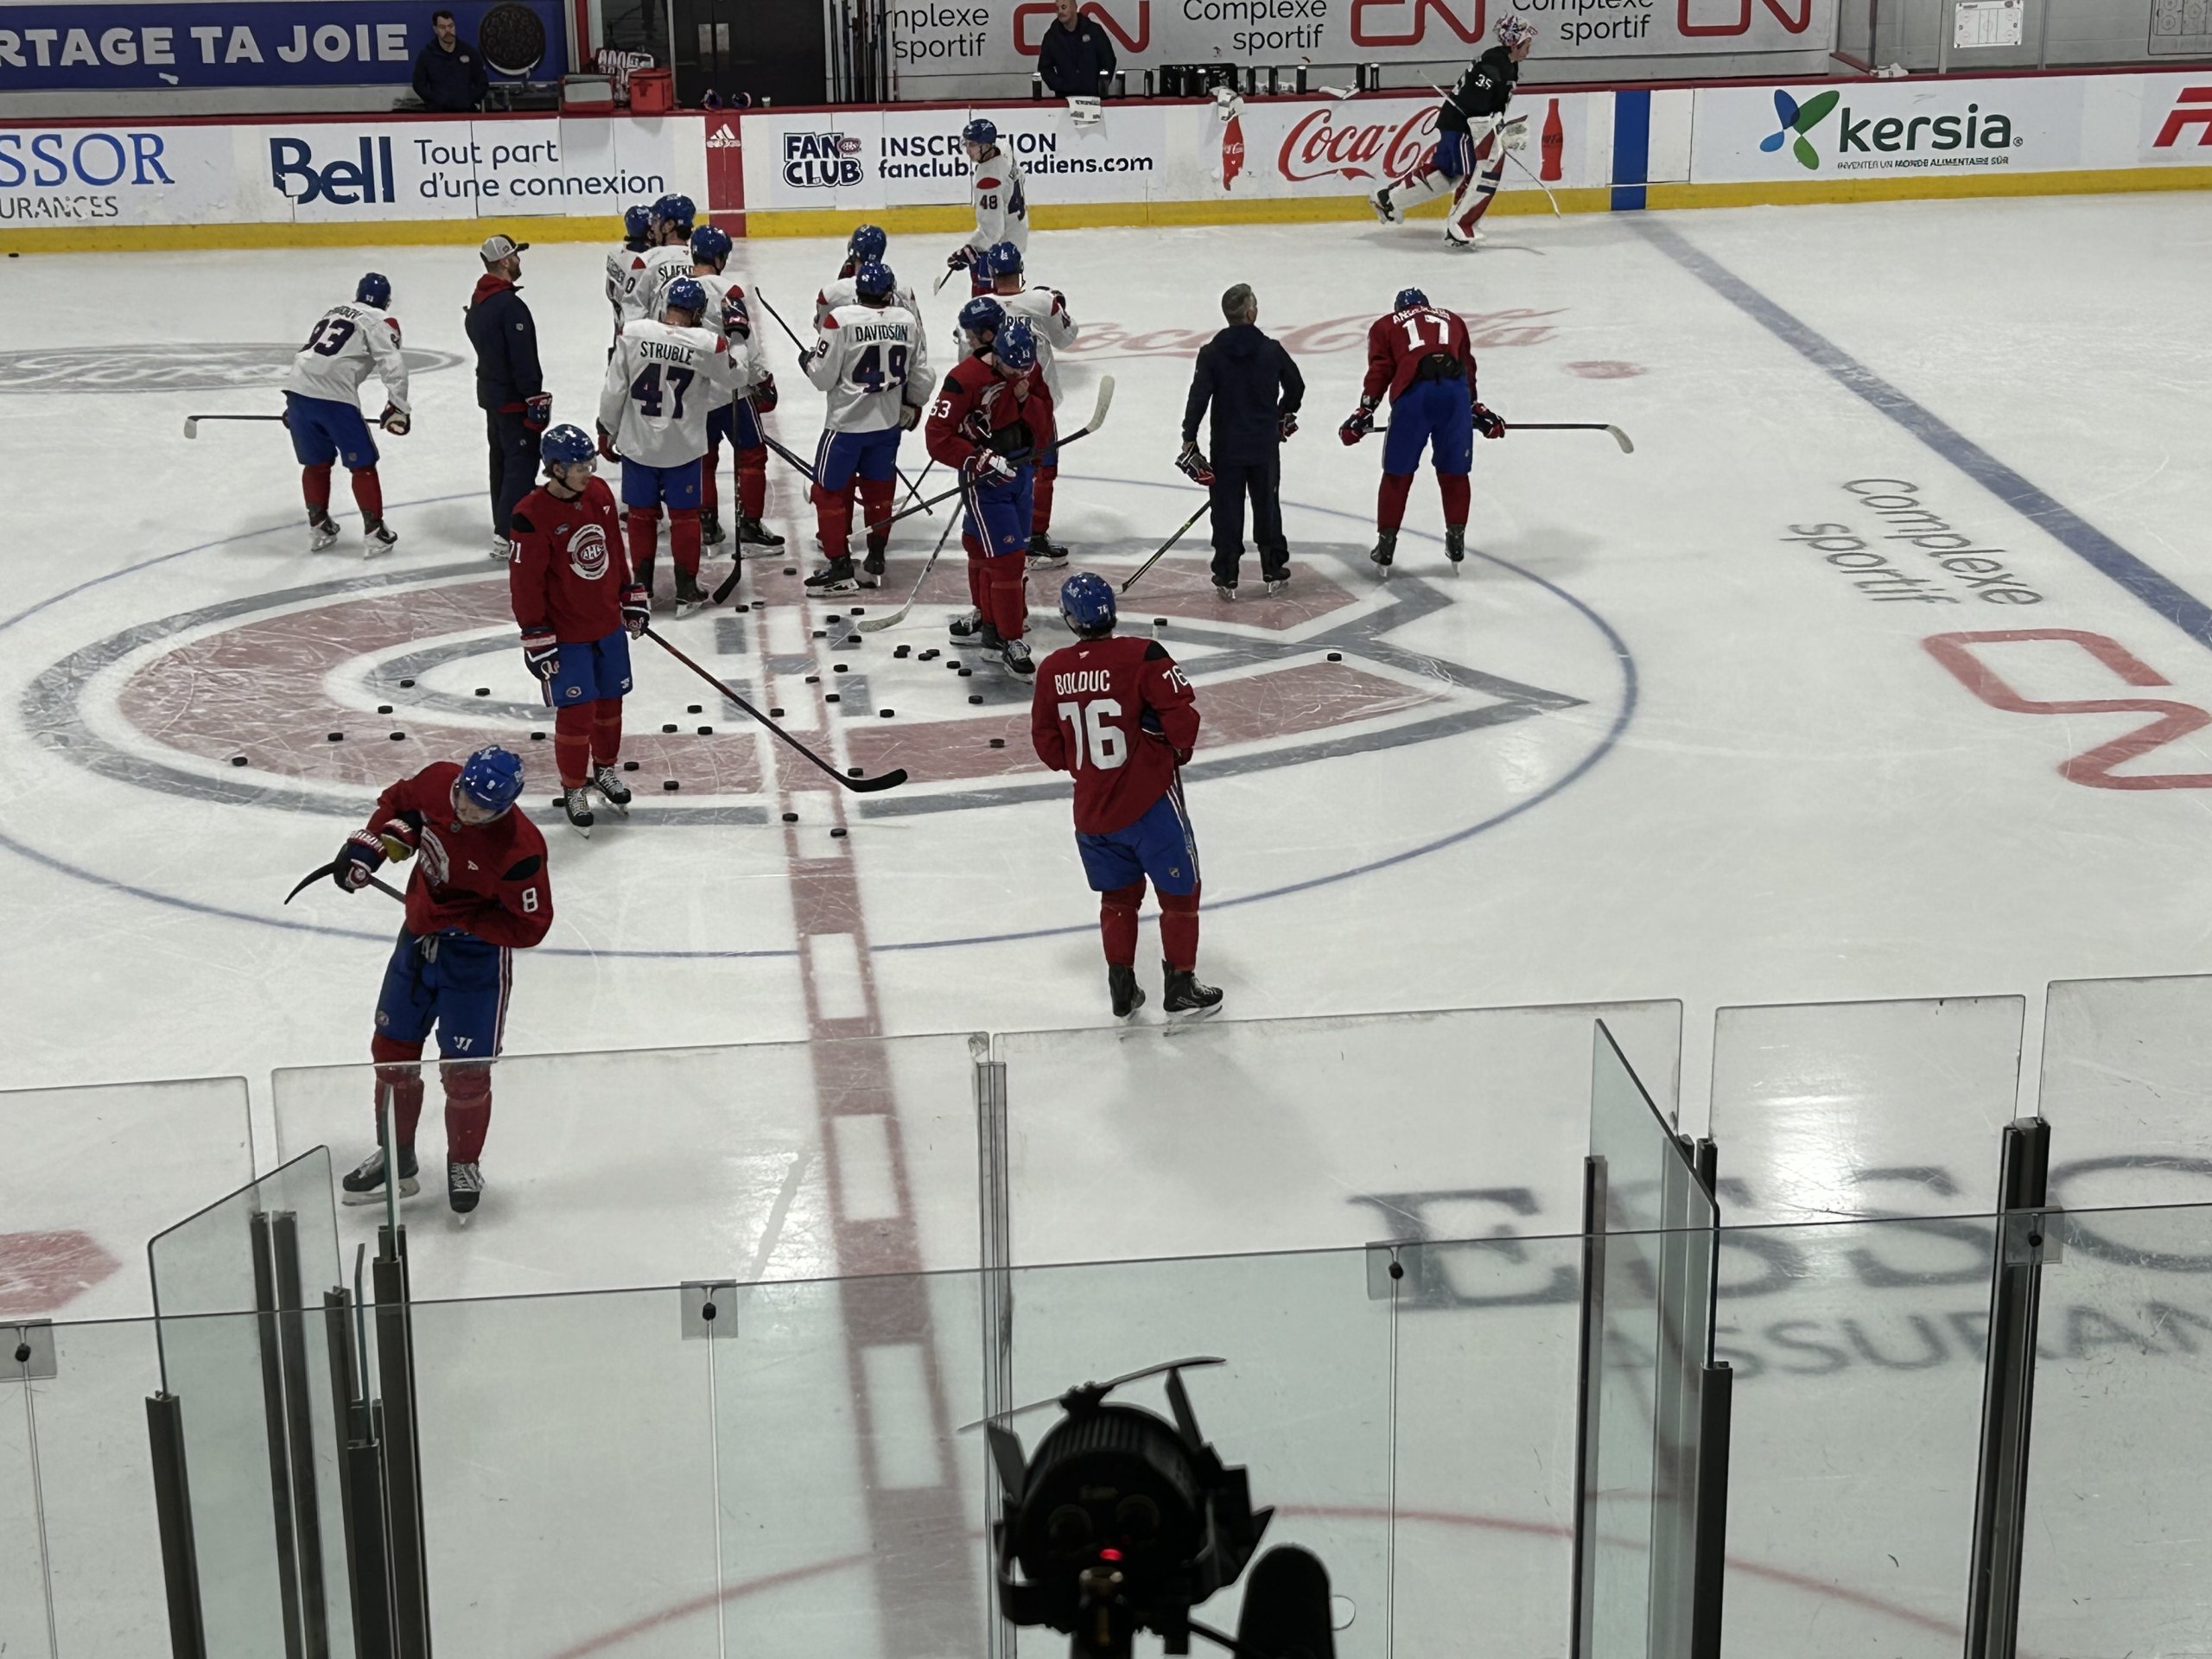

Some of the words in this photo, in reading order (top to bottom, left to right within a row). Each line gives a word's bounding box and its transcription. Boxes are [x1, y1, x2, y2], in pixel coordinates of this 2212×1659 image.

[885, 3, 989, 34] mplexe
[1183, 0, 1327, 26] Complexe
[1351, 0, 1485, 47] CN
[0, 27, 175, 67] RTAGE
[190, 26, 264, 64] TA
[276, 23, 410, 63] JOIE
[1233, 24, 1324, 55] sportif
[1560, 14, 1651, 45] sportif
[893, 32, 987, 64] sportif
[1474, 73, 1493, 90] 35
[1839, 103, 2012, 153] kersia
[414, 139, 482, 165] Tout
[493, 140, 559, 169] part
[785, 133, 842, 161] FAN
[269, 136, 396, 205] Bell
[420, 172, 499, 198] d'une
[510, 169, 664, 195] connexion
[783, 159, 863, 187] CLUB
[979, 194, 998, 210] 48
[855, 324, 908, 342] DAVIDSON
[1402, 313, 1450, 352] 17
[640, 340, 695, 365] STRUBLE
[851, 344, 907, 393] 49
[630, 362, 695, 419] 47
[1842, 478, 2044, 605] Complexe
[1779, 523, 1961, 604] sportif
[1054, 670, 1110, 696] BOLDUC
[1057, 698, 1128, 771] 76
[521, 887, 539, 913] 8
